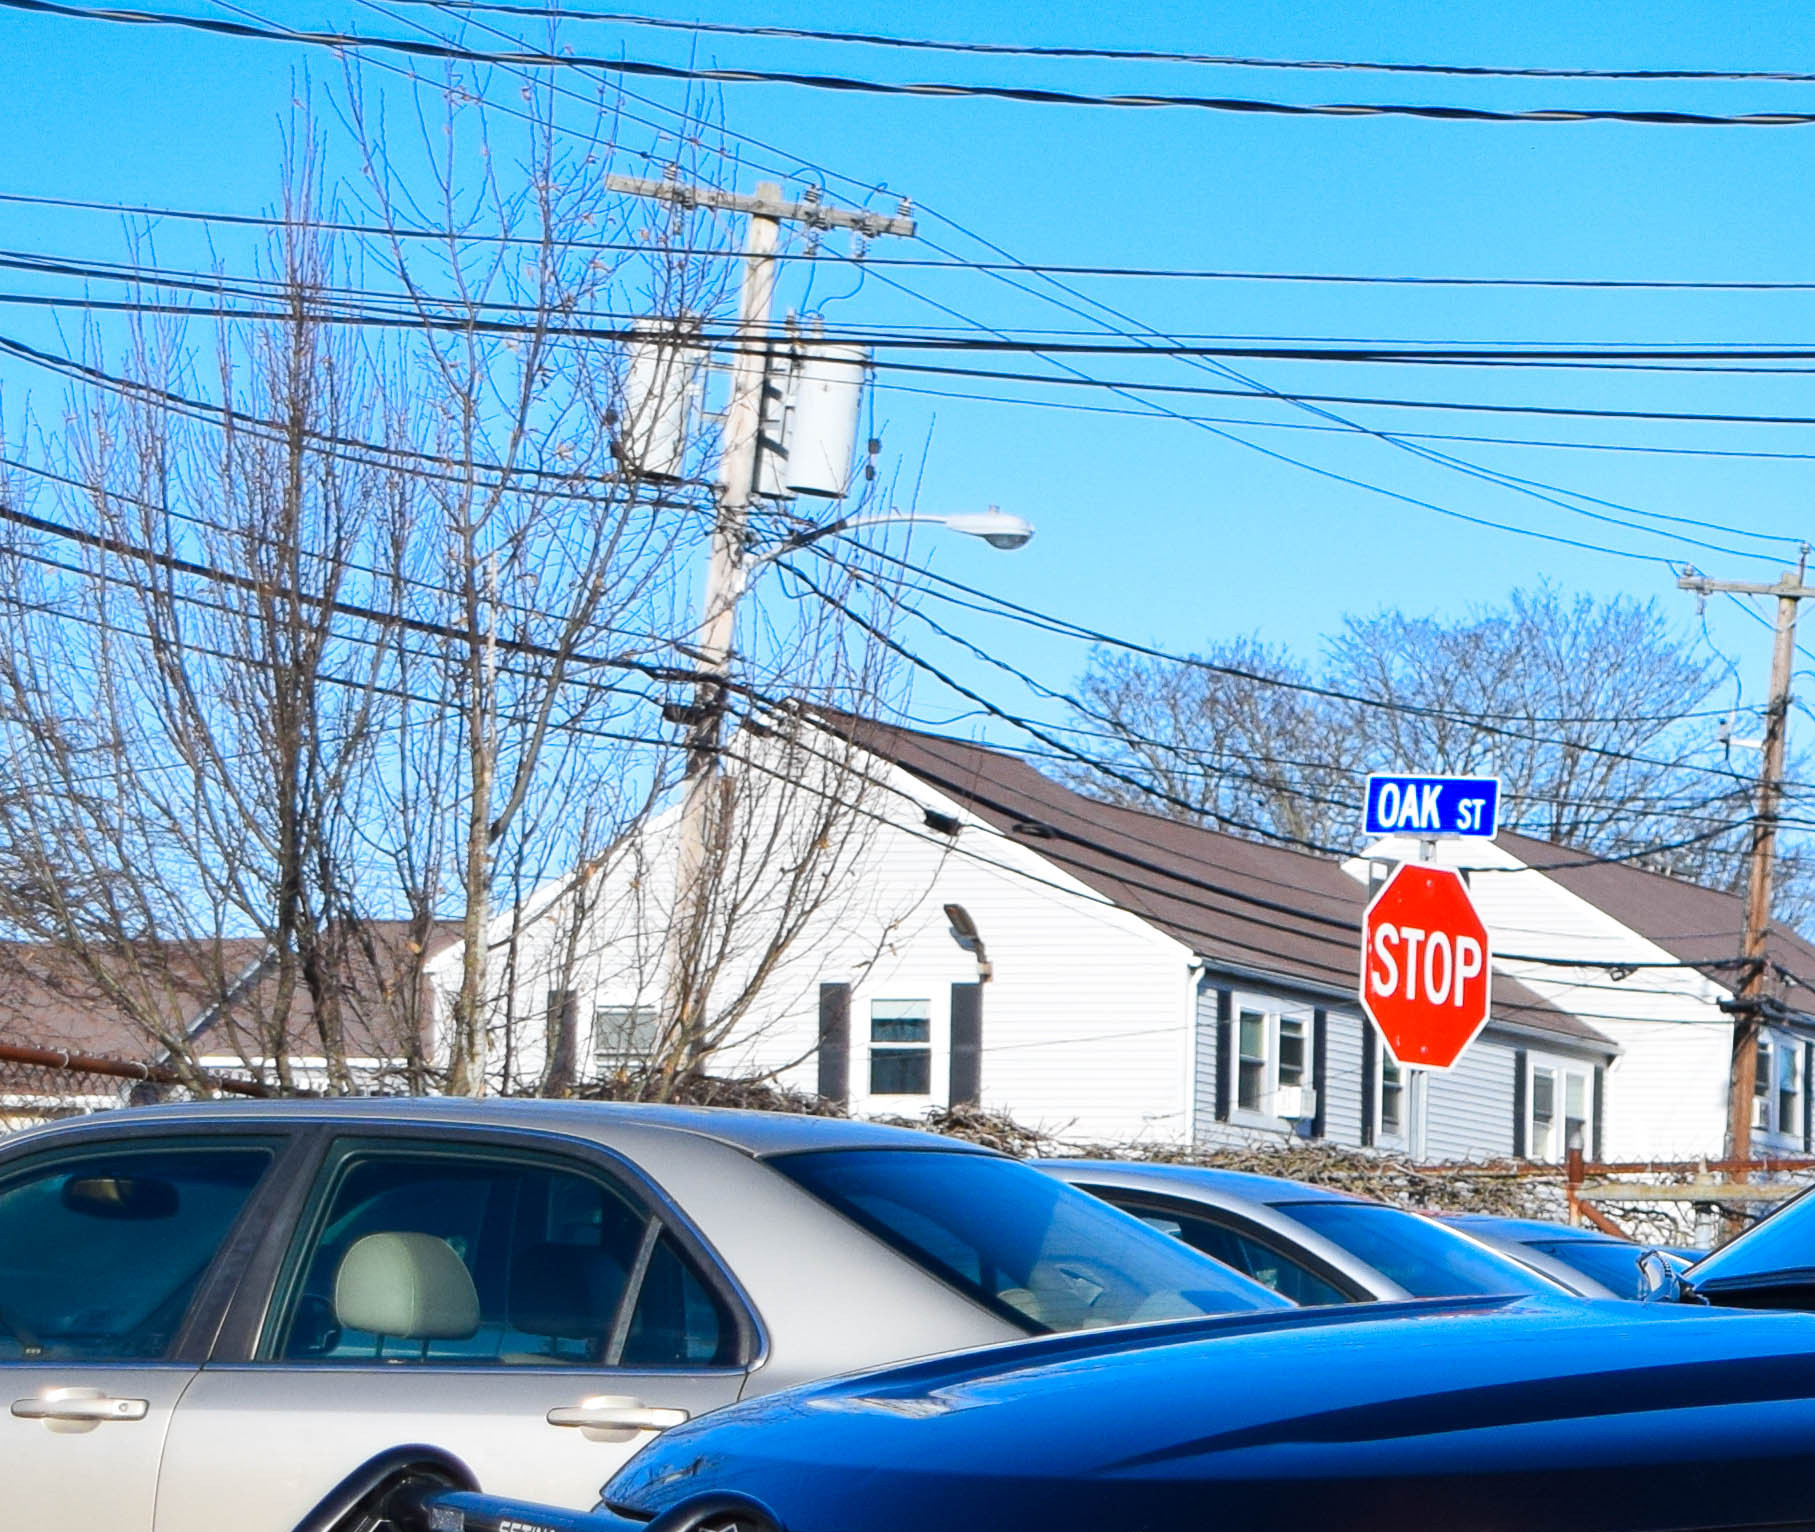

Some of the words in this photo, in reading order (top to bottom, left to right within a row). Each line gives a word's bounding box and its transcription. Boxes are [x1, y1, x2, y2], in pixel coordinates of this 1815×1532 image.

[1377, 782, 1442, 829] OAK
[1456, 798, 1486, 831] ST
[1371, 922, 1483, 1007] STOP
